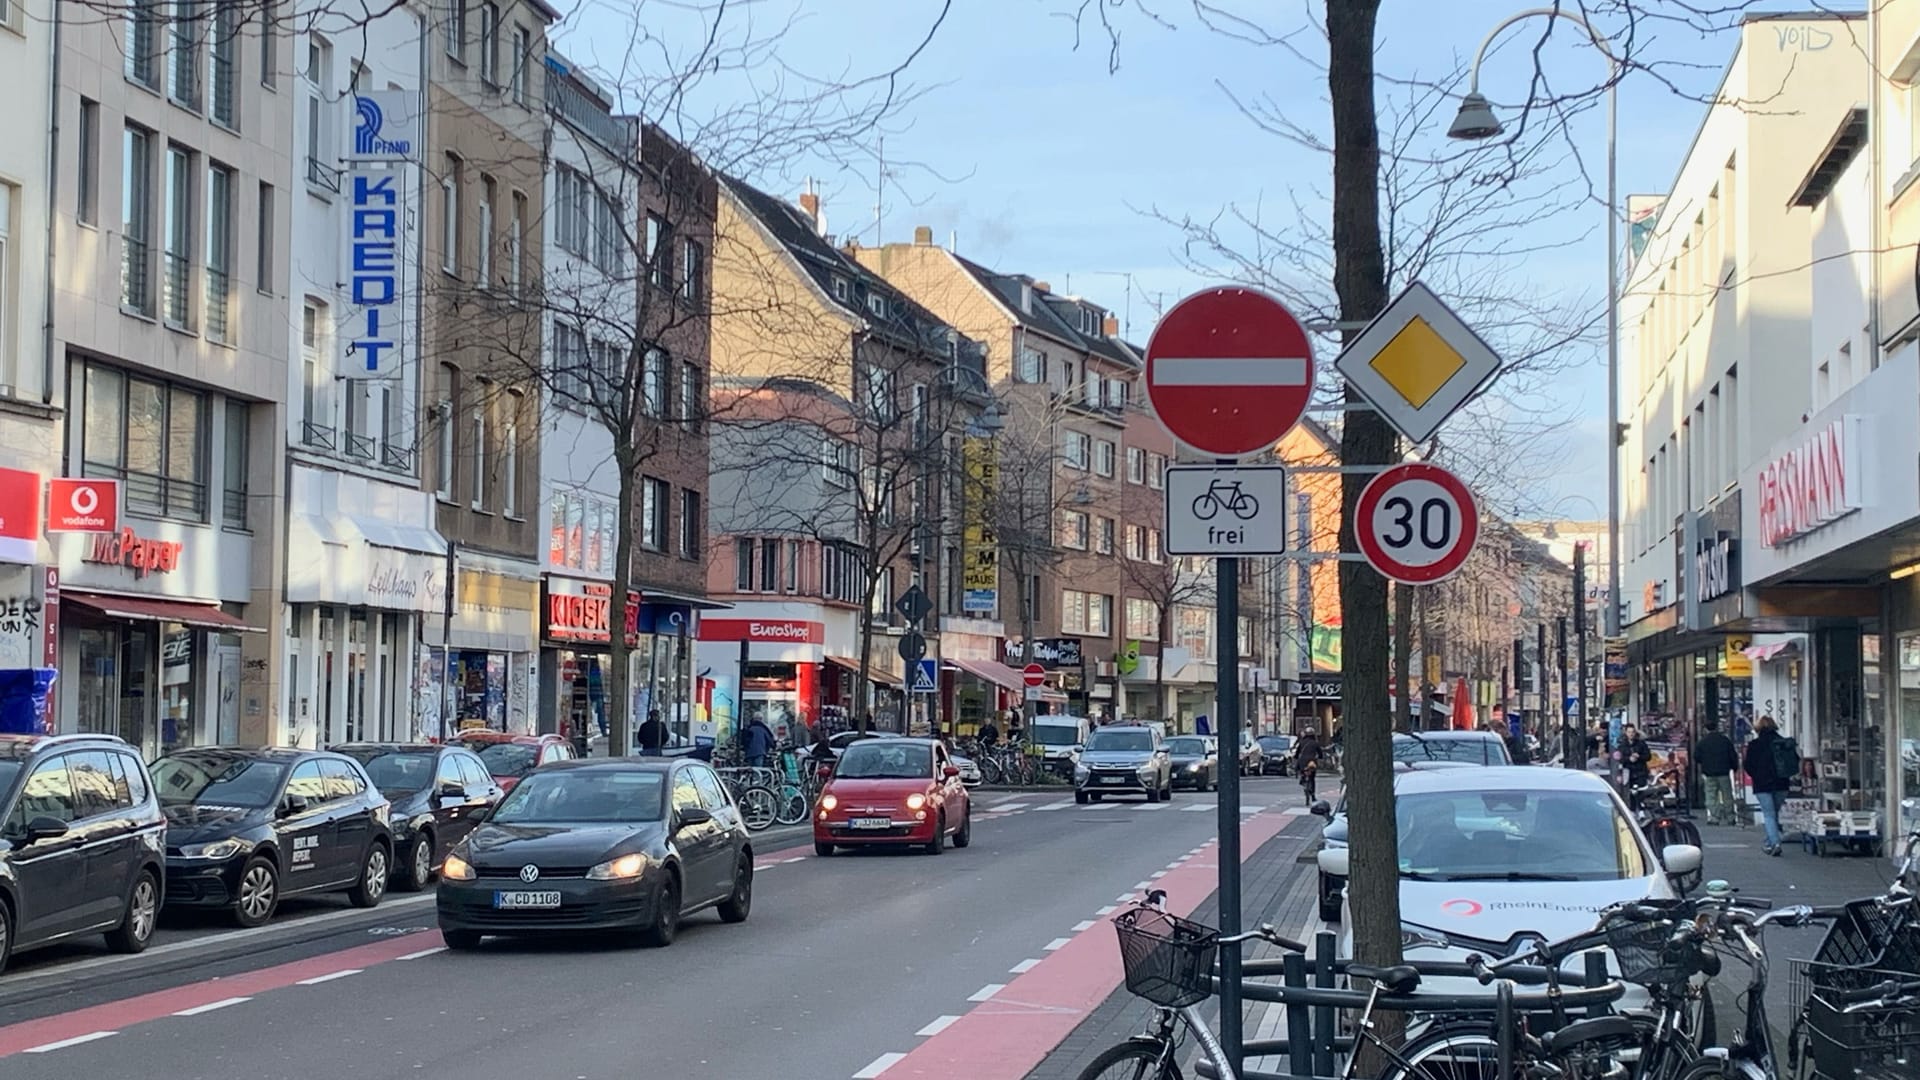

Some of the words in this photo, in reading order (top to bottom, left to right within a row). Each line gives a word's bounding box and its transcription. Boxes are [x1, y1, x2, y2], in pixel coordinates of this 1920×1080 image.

[374, 140, 411, 154] PFAND
[352, 175, 396, 371] KREDIT
[62, 516, 105, 527] vodafone
[1382, 497, 1451, 549] 30
[1208, 527, 1244, 545] frei
[91, 526, 183, 580] McPaper
[965, 573, 995, 586] HAUS
[550, 594, 611, 631] KIOSK
